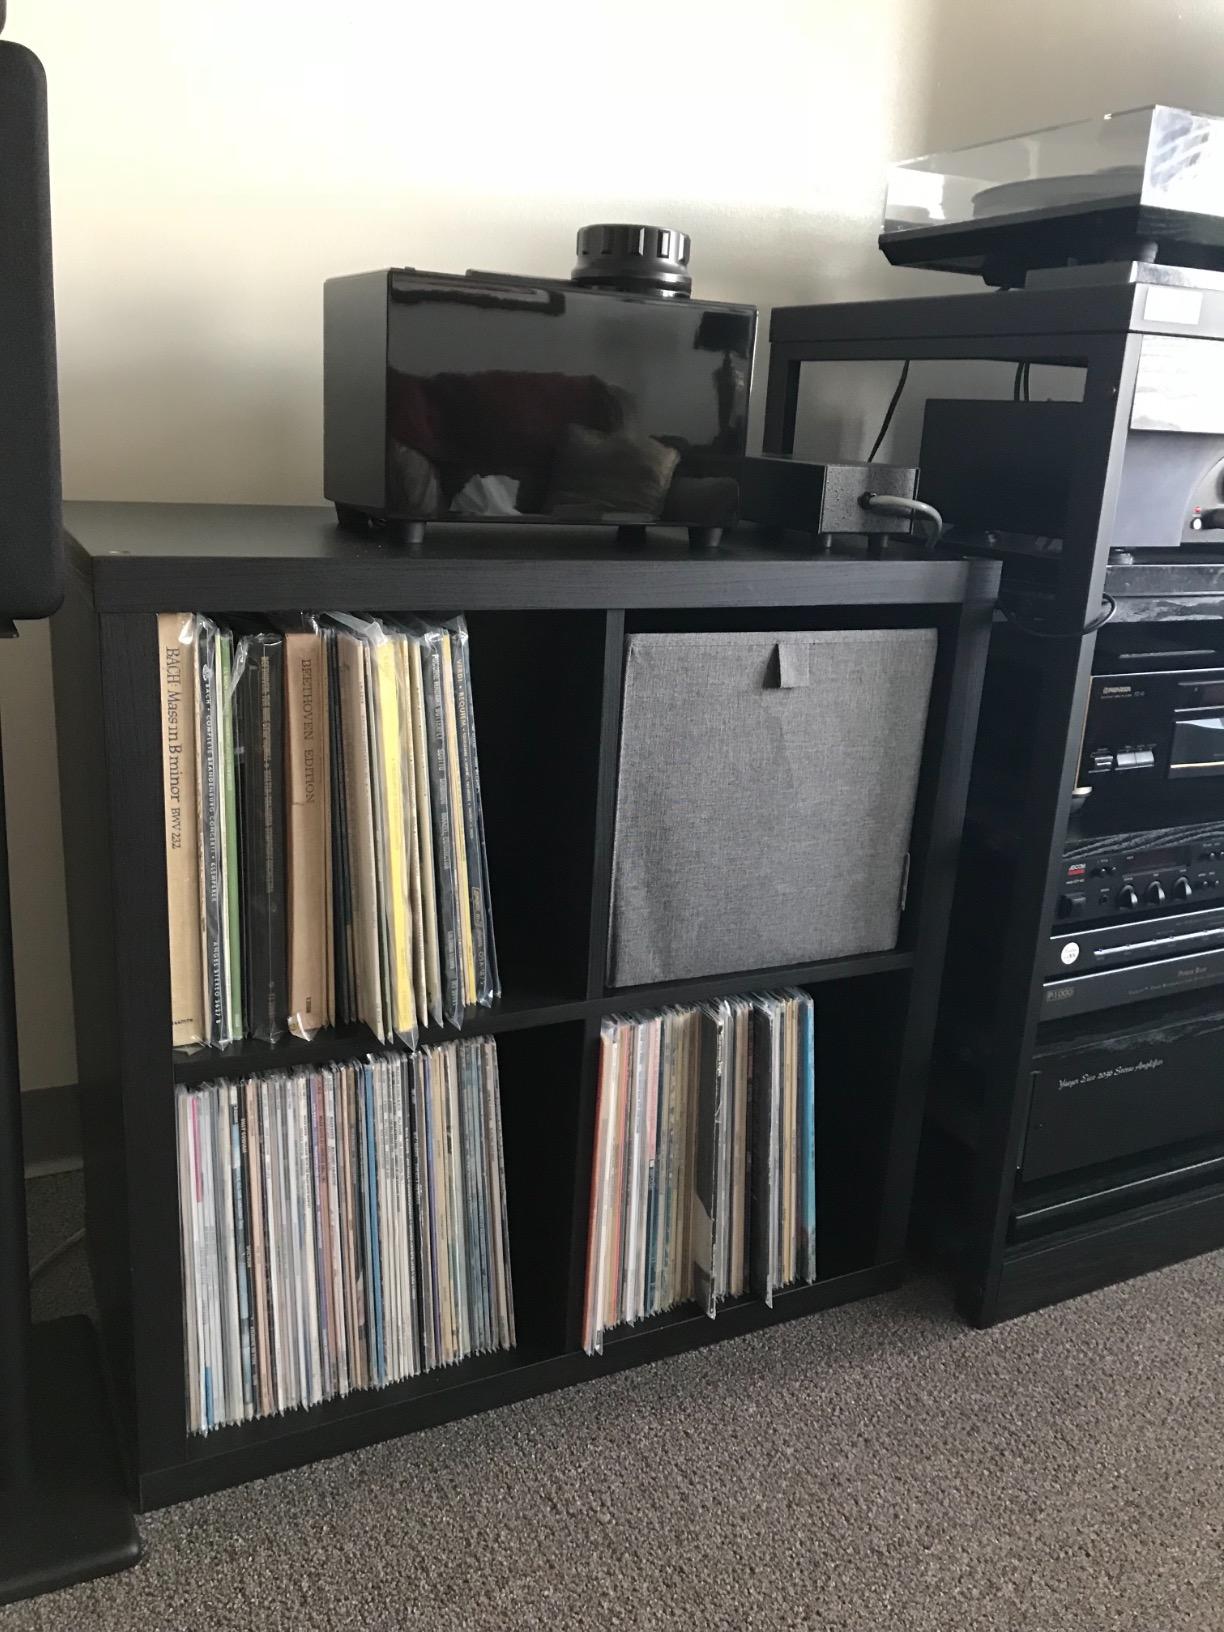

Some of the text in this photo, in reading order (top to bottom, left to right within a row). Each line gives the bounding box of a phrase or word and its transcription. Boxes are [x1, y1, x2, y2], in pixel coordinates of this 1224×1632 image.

[168, 690, 182, 725] Mass
[168, 726, 179, 742] in
[301, 658, 316, 804] BEETHOVEN EDITION
[169, 743, 183, 754] B
[170, 756, 183, 803] minor
[171, 807, 181, 832] BWV
[172, 833, 182, 850] 232
